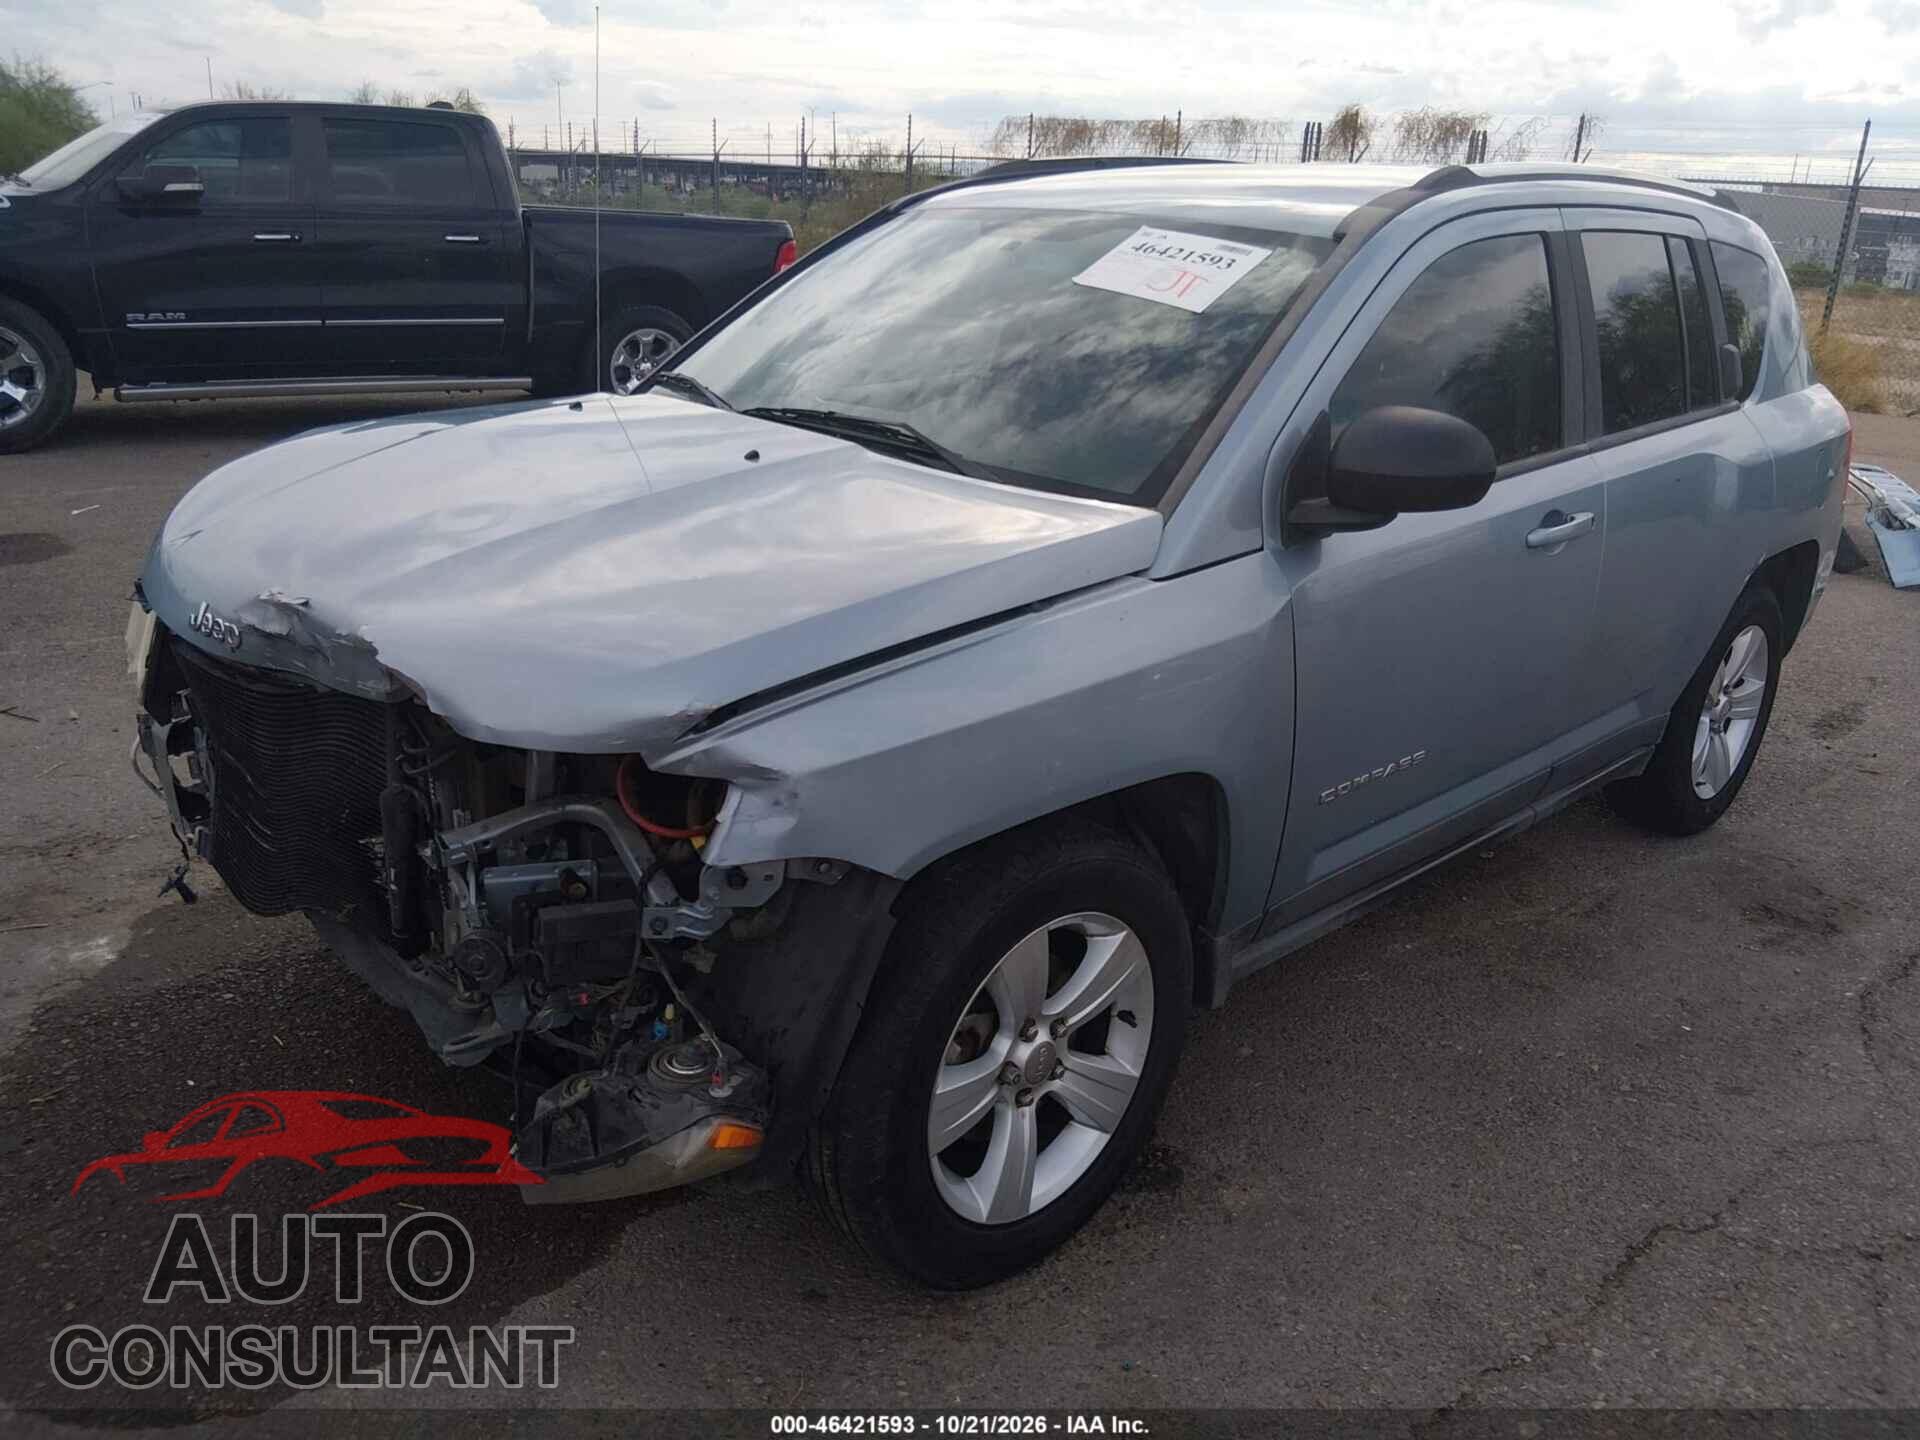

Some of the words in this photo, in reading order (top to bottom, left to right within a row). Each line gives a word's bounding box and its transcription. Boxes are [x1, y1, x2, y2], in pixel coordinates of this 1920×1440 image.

[1131, 242, 1237, 271] 46421593
[126, 312, 187, 321] RAM
[1320, 750, 1427, 804] COMPASS
